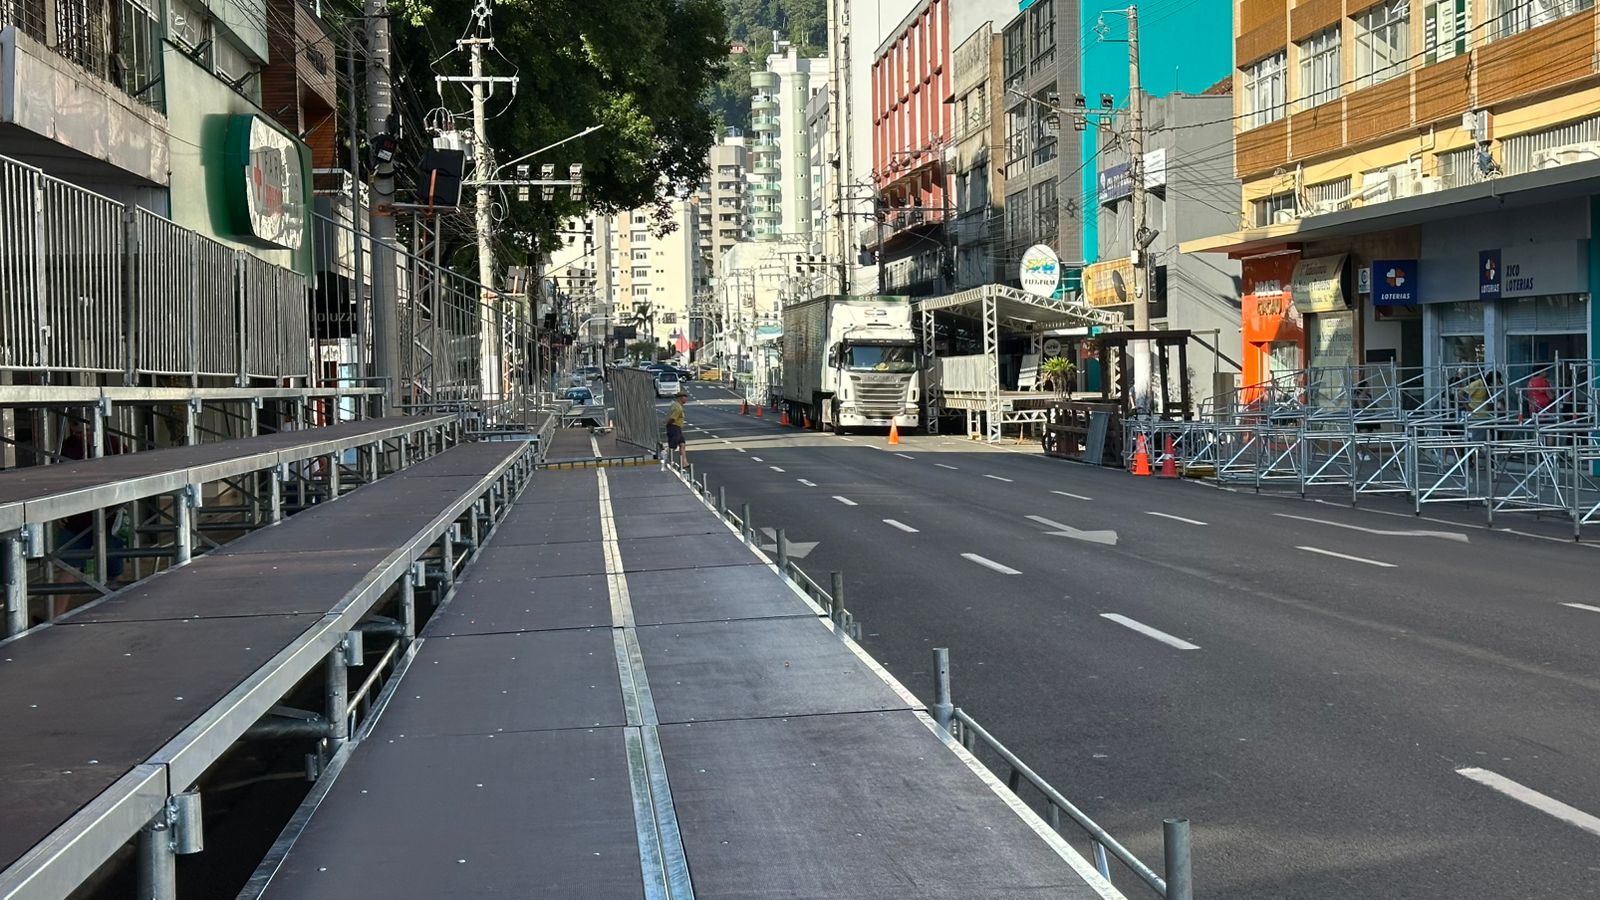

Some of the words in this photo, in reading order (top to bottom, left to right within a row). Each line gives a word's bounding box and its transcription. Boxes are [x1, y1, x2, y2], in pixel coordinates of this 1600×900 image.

[1506, 264, 1520, 277] XICO
[1481, 283, 1500, 294] LOTERIAS
[1506, 277, 1534, 292] LOTERIAS
